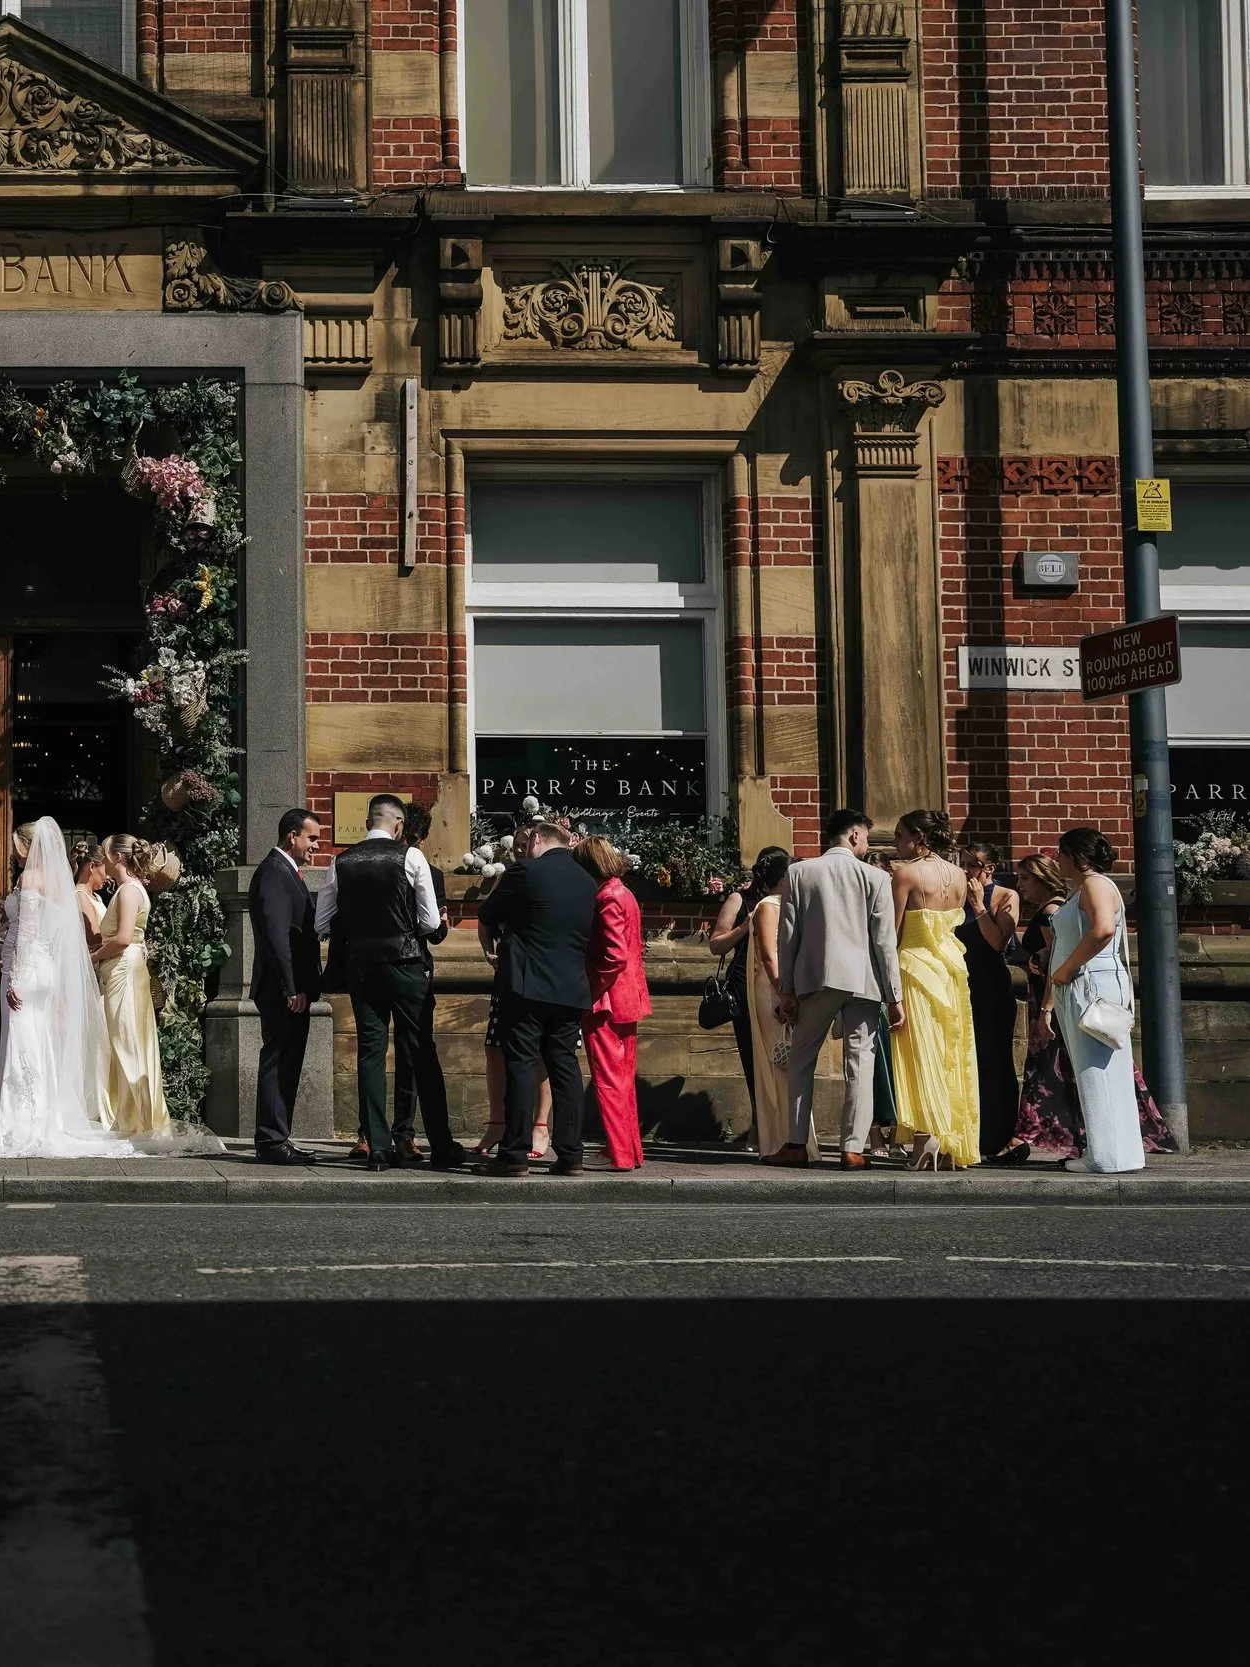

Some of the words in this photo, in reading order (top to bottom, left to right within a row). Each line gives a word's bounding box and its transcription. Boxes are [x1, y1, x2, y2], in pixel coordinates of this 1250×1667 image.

[0, 243, 132, 294] BANK
[1038, 564, 1062, 573] BELL
[1113, 631, 1141, 650] NEW
[968, 657, 1051, 677] WINWICK
[1086, 641, 1173, 675] ROUNDABOUT
[1086, 675, 1106, 692] 100
[1108, 672, 1126, 690] yds
[1131, 660, 1174, 682] AHEAD
[571, 759, 611, 771] THE
[482, 778, 596, 796] PARR'S
[617, 779, 700, 796] BANK
[627, 805, 661, 818] Events
